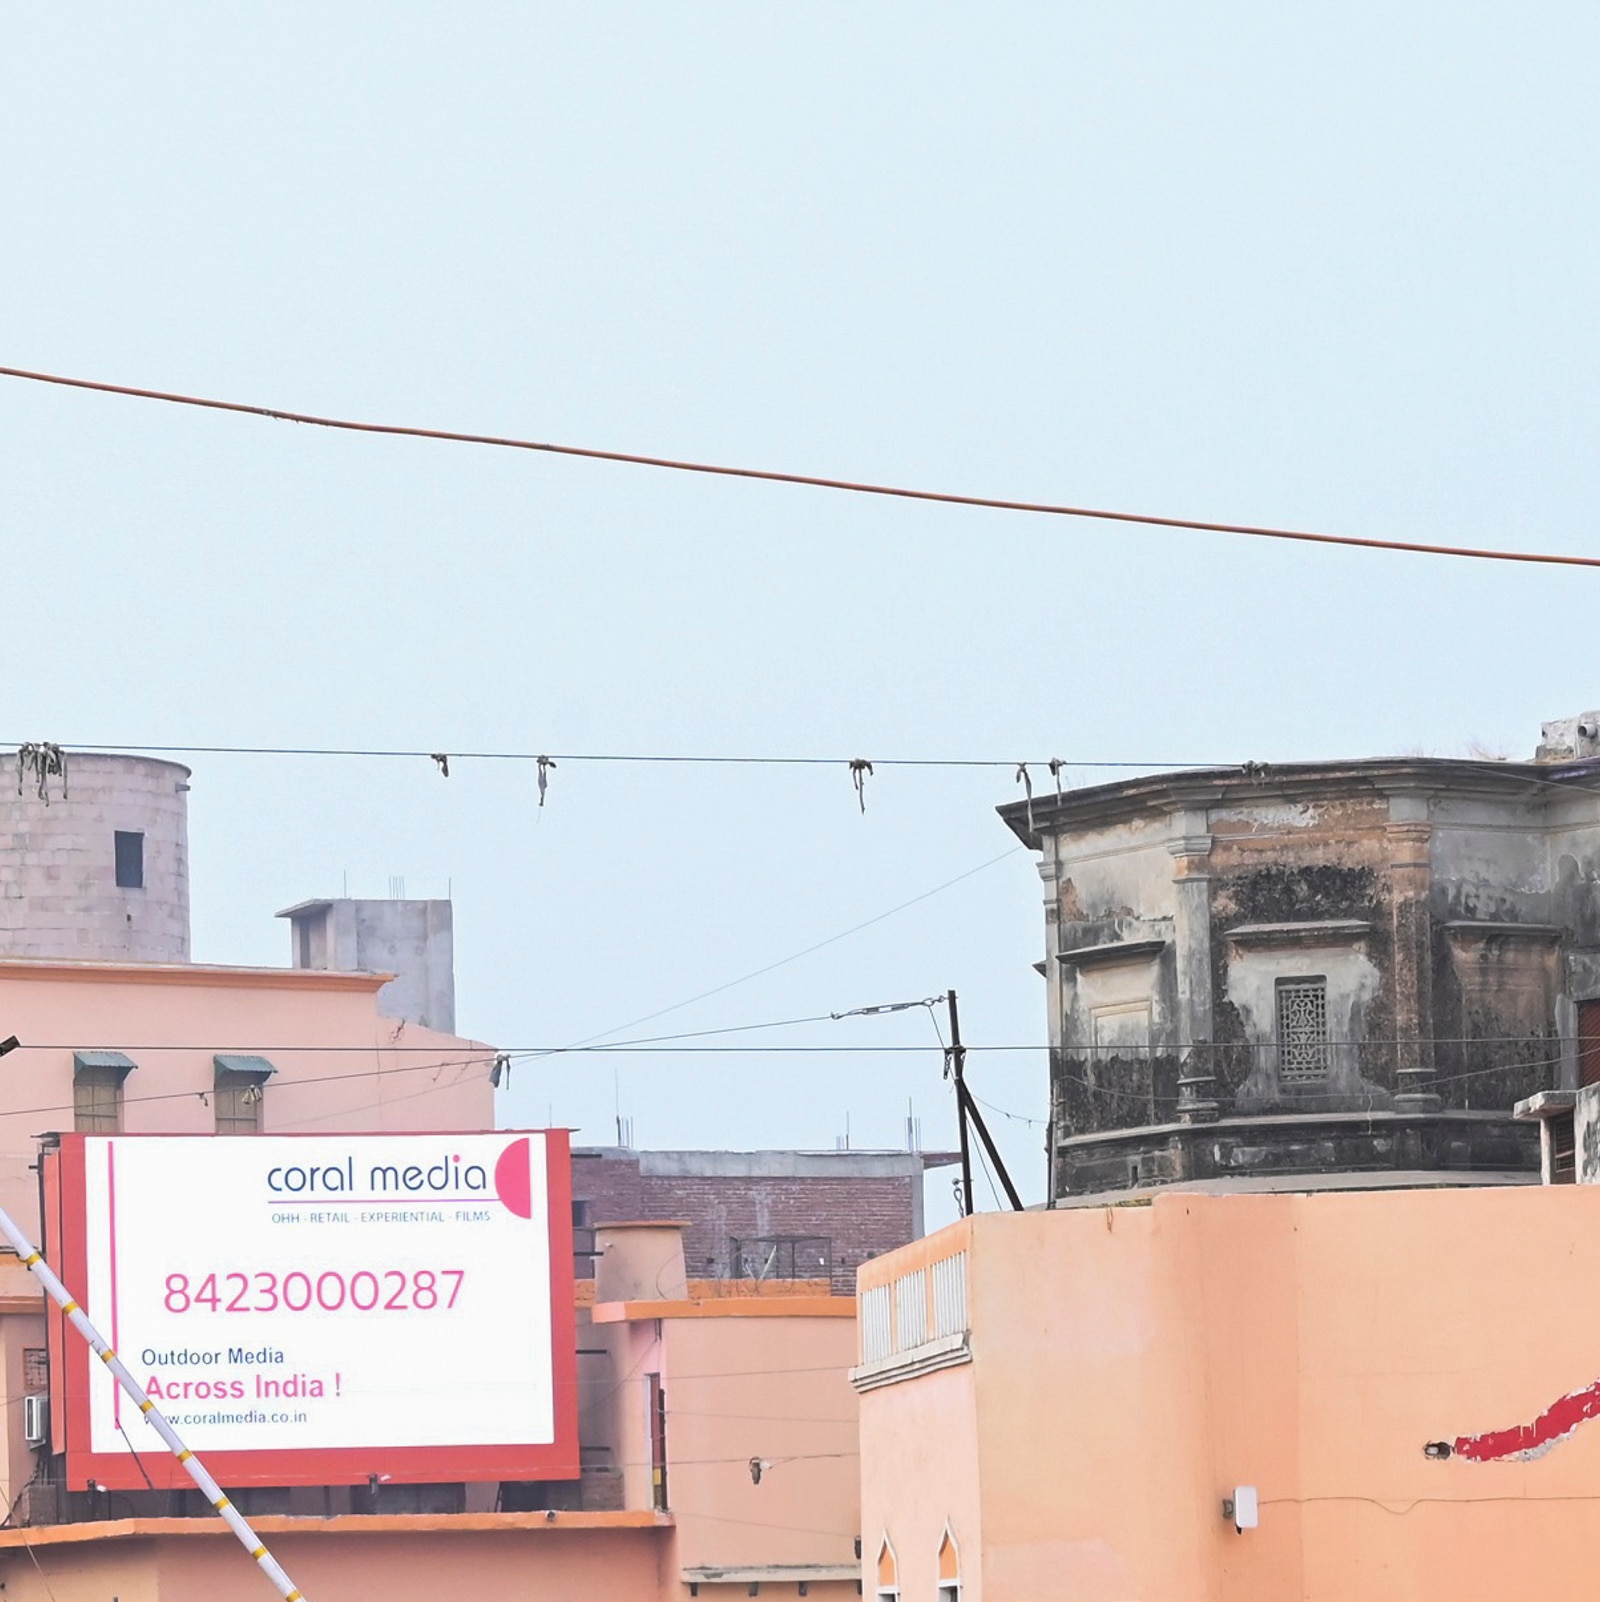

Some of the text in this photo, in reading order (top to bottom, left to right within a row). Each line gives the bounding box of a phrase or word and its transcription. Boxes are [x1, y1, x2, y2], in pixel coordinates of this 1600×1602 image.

[267, 1154, 487, 1191] coral media
[271, 1210, 491, 1225] OHH RETAIL EXPERIENTIAL FILMS
[163, 1269, 465, 1314] 8423000287
[141, 1346, 285, 1367] Outdoor Media
[145, 1375, 245, 1401] Across
[255, 1373, 325, 1399] India
